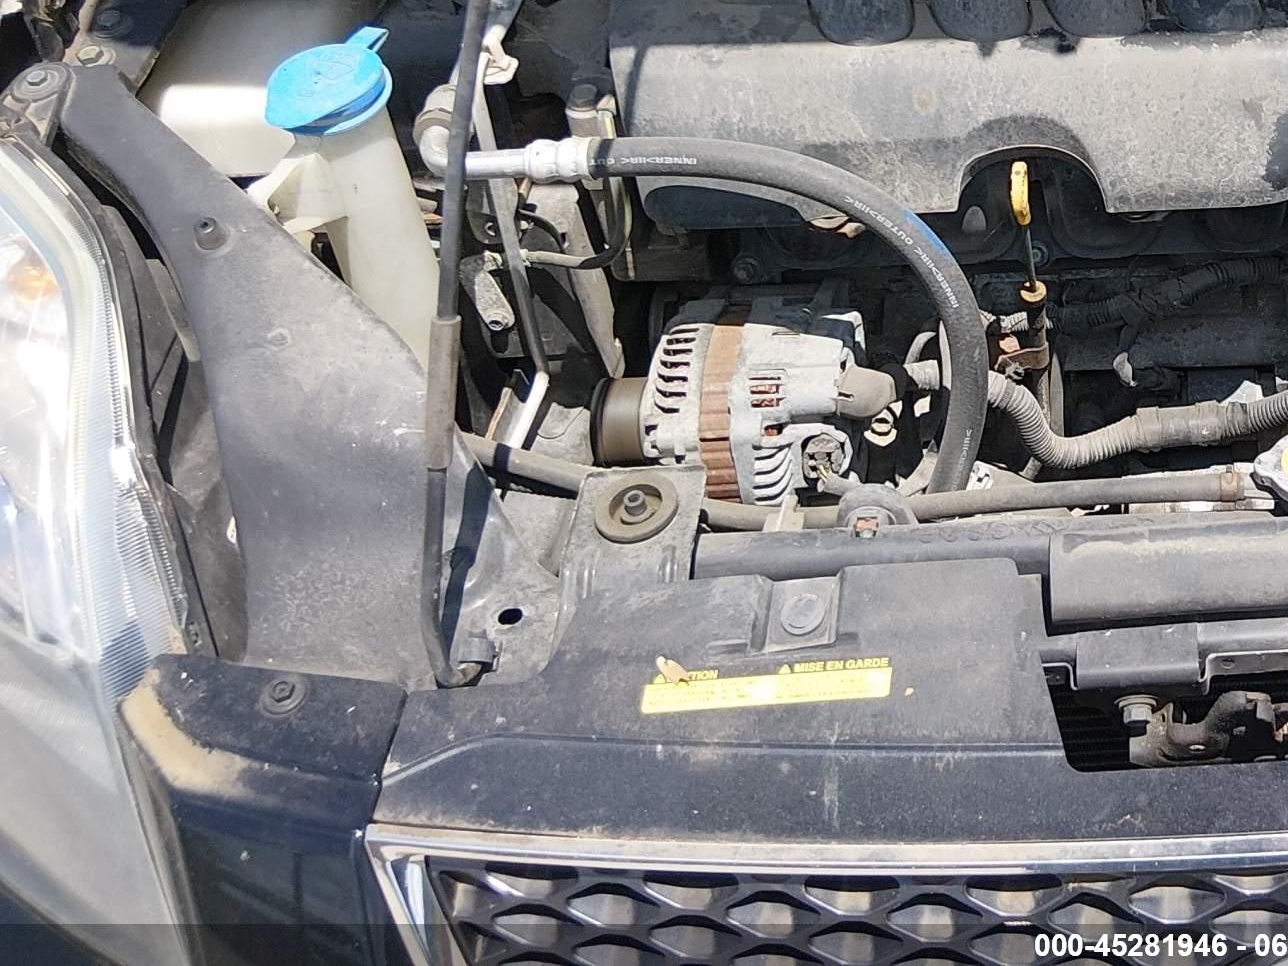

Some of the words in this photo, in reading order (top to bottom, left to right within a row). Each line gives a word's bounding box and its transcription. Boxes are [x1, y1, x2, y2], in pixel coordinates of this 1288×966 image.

[793, 661, 825, 673] MISE
[826, 659, 844, 671] EN
[845, 656, 890, 670] GARDE
